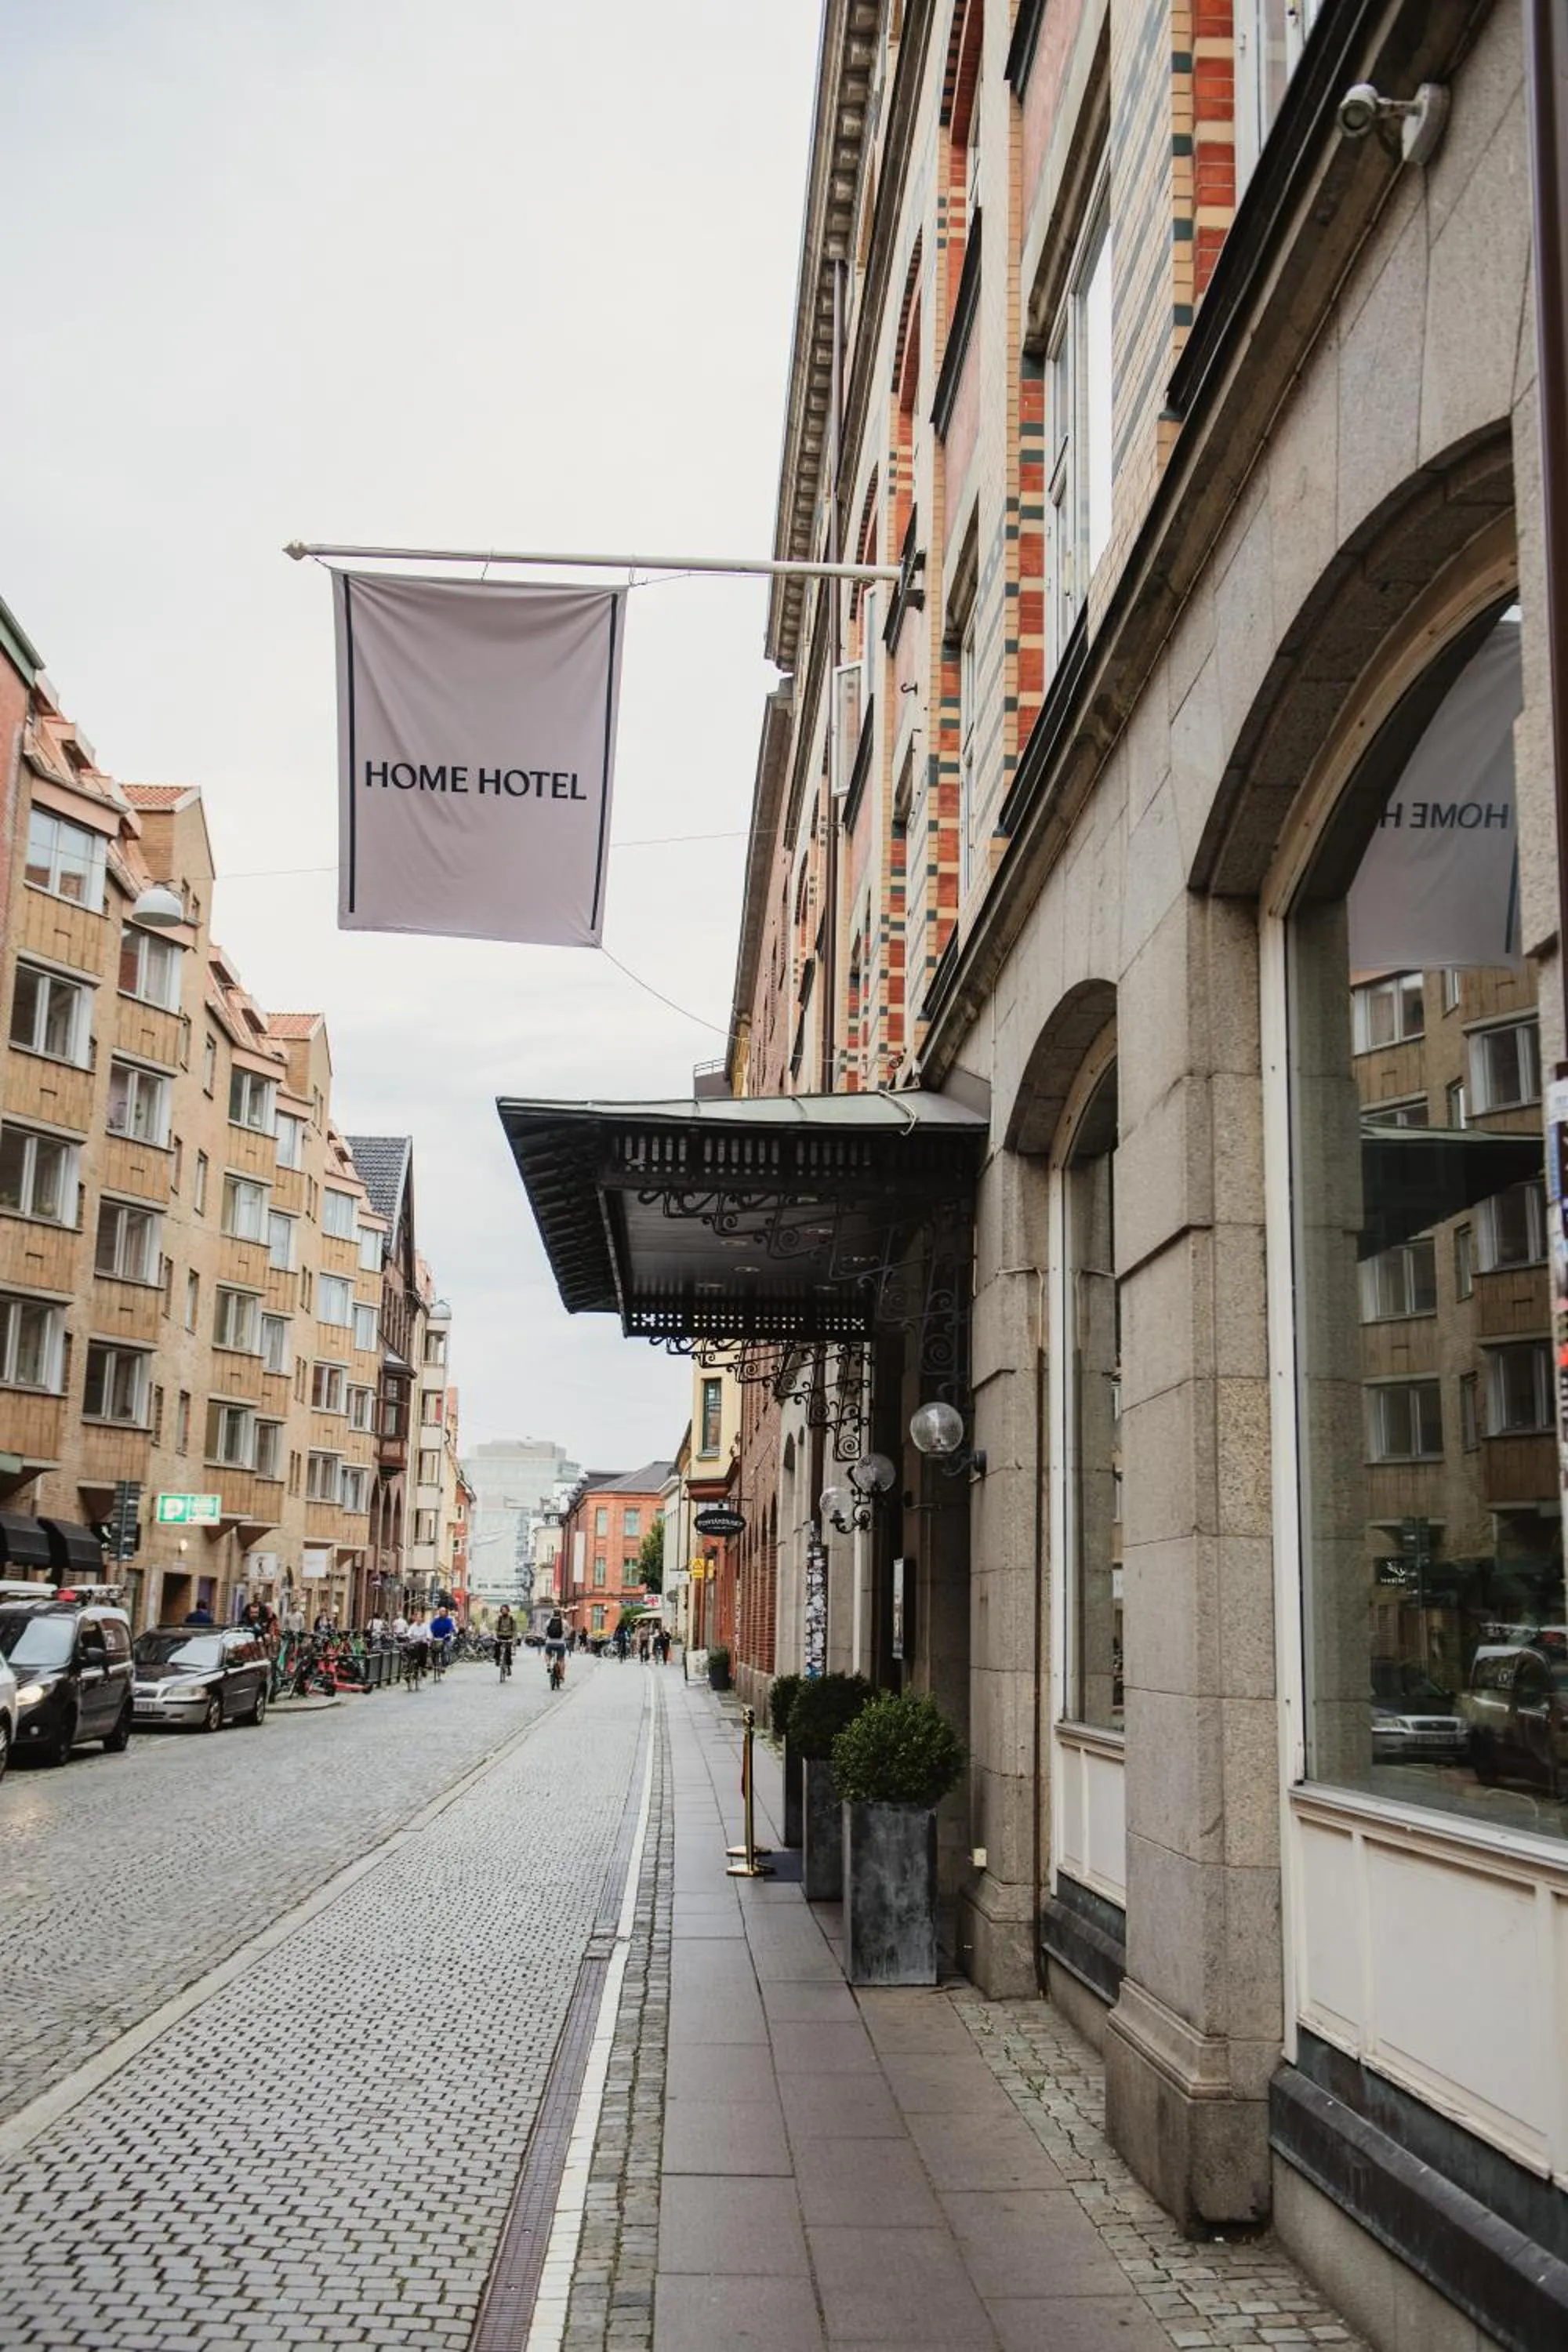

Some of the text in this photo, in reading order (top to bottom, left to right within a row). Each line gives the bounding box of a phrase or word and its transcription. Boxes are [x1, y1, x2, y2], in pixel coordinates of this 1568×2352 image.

[365, 760, 587, 800] HOME HOTEL
[163, 1498, 183, 1520] P
